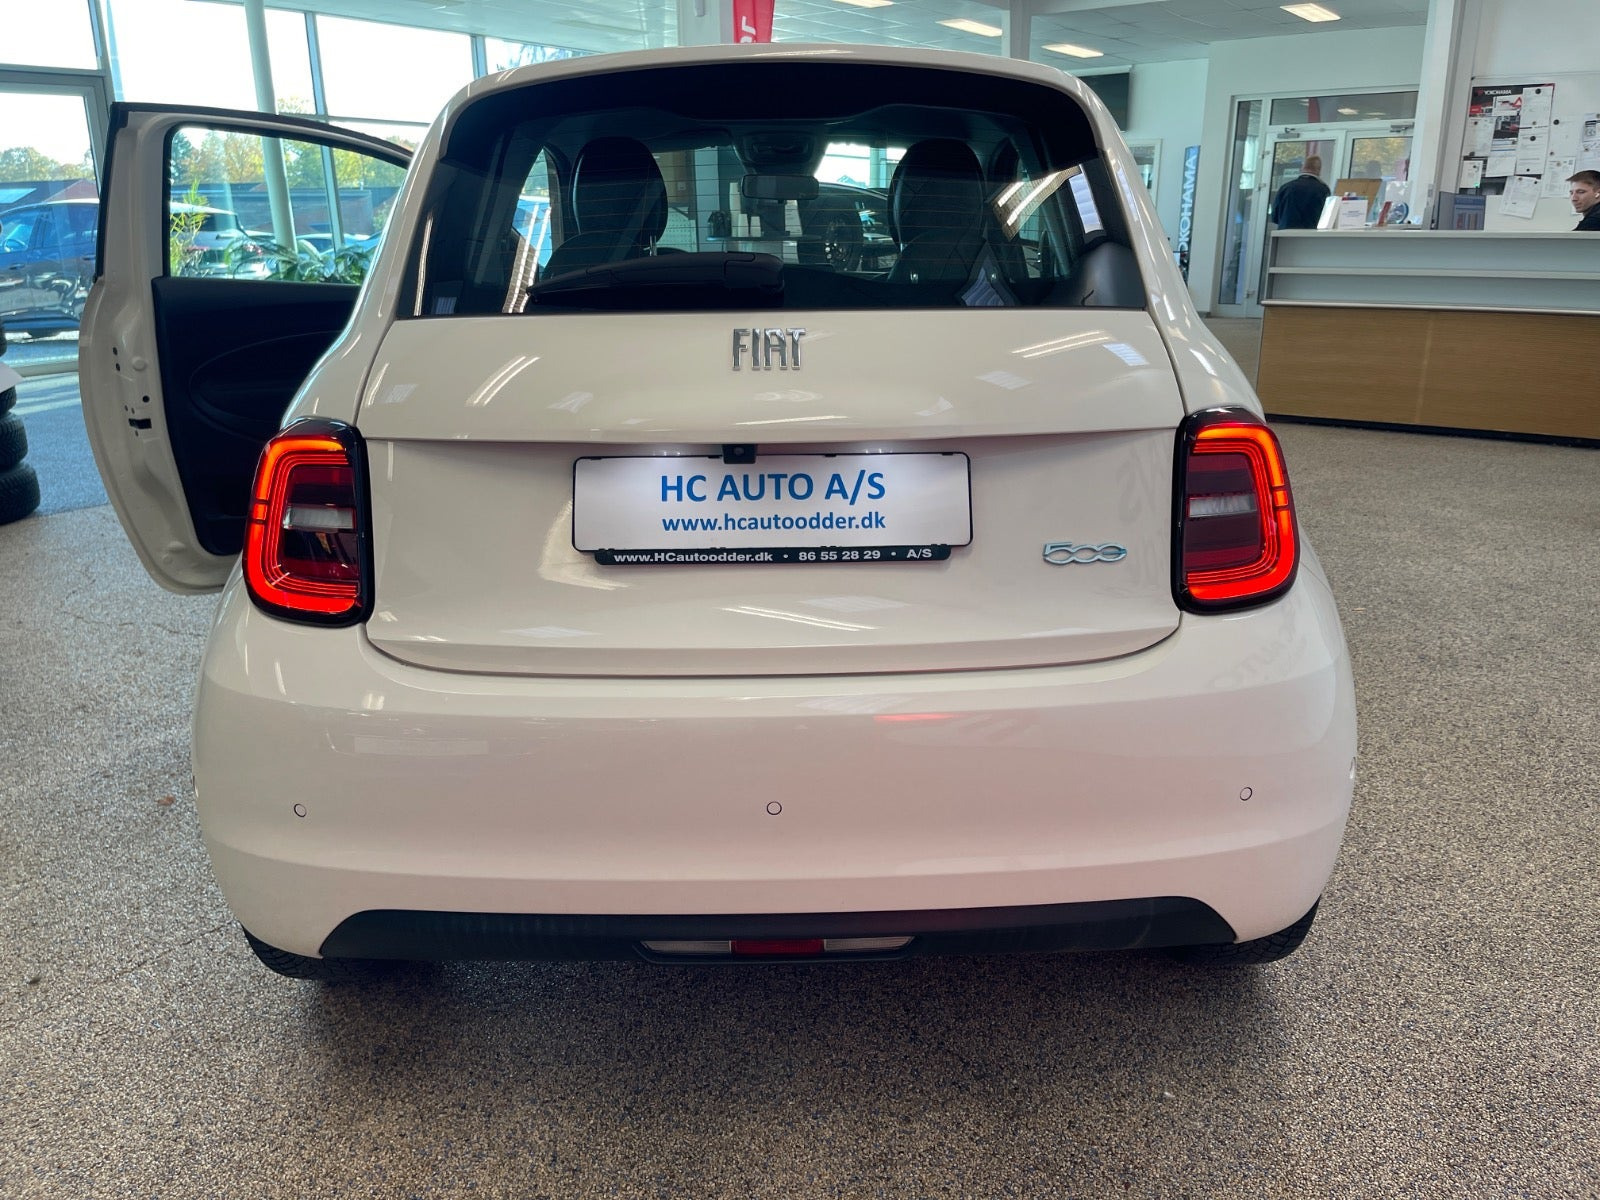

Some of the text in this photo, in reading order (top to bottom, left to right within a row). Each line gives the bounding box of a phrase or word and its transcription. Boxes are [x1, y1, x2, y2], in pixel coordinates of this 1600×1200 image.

[732, 327, 806, 370] FIAT
[661, 469, 886, 506] HC AUTO A/S
[661, 511, 886, 531] www.hcautoodder.dk
[614, 548, 933, 563] www.HCautoodder.dk 86 55 28 29 A/S
